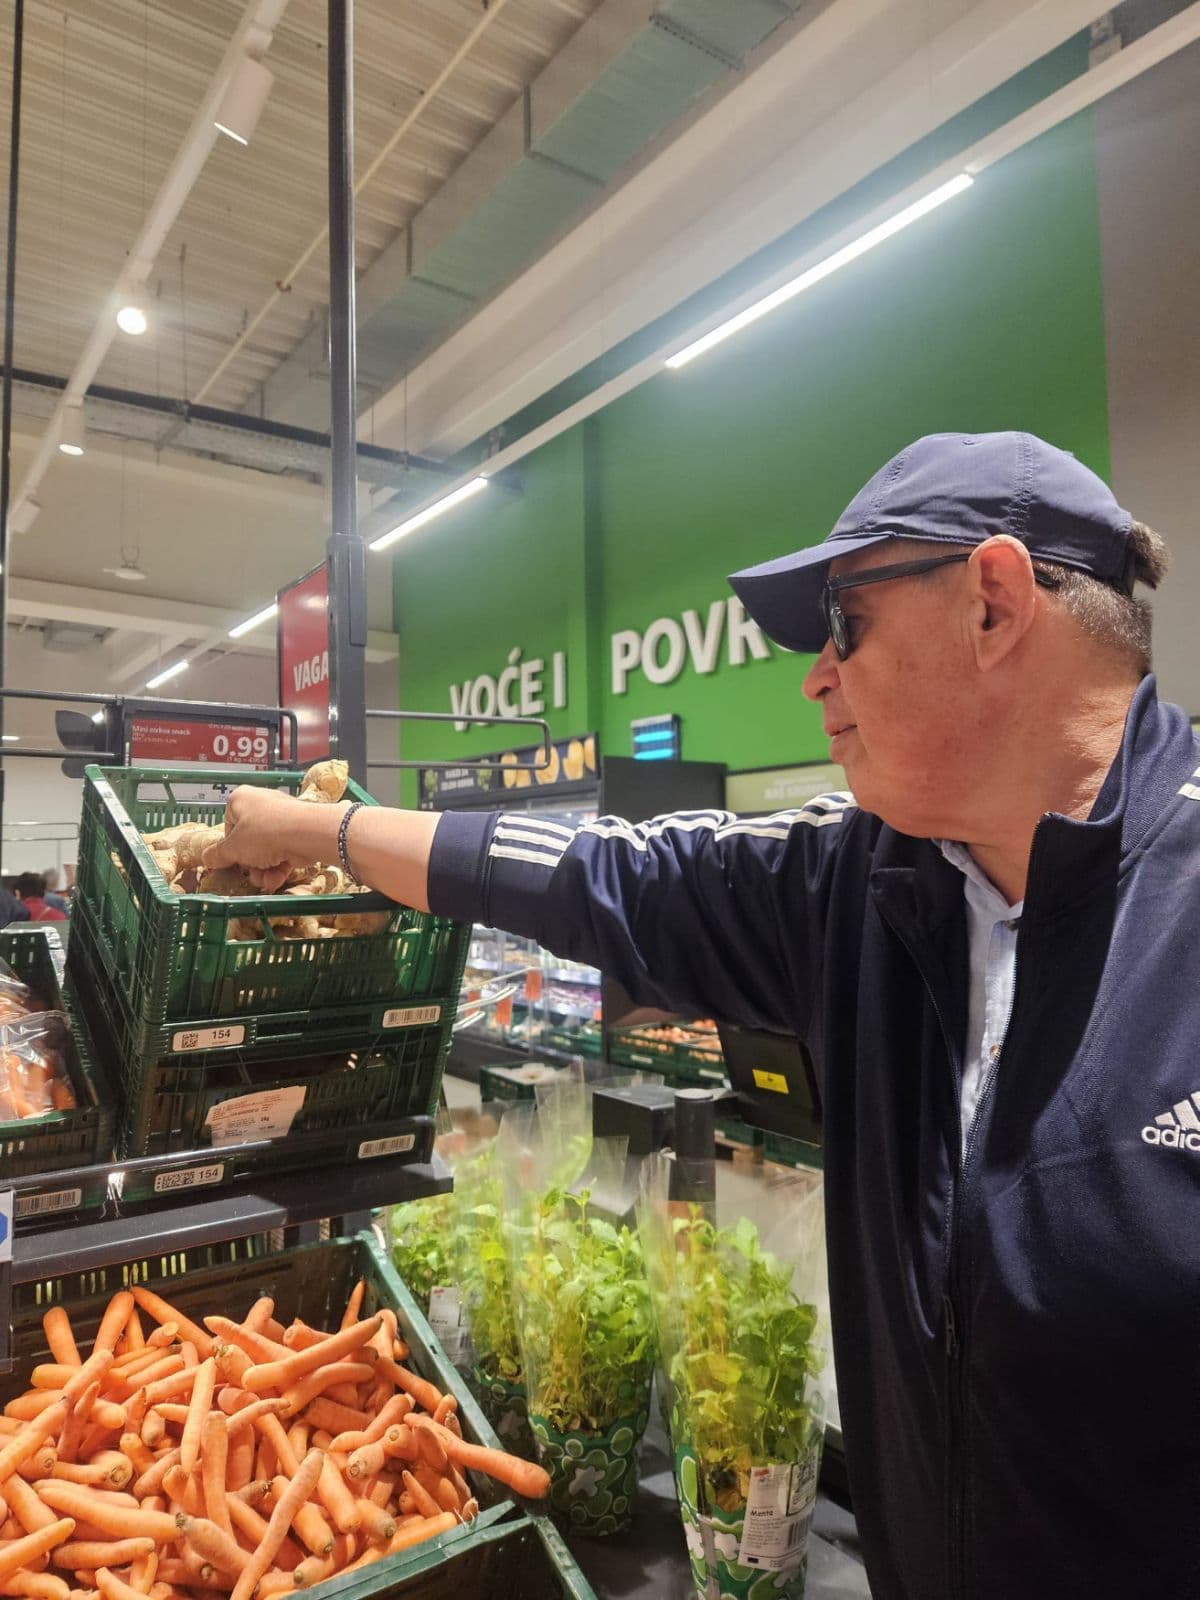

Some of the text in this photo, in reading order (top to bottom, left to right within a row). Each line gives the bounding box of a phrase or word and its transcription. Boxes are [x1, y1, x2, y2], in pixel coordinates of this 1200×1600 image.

[293, 651, 329, 692] VAGA
[450, 594, 772, 732] VOĆE I POVR
[213, 735, 268, 758] 0.99
[212, 1029, 231, 1039] 154
[200, 1169, 218, 1179] 154
